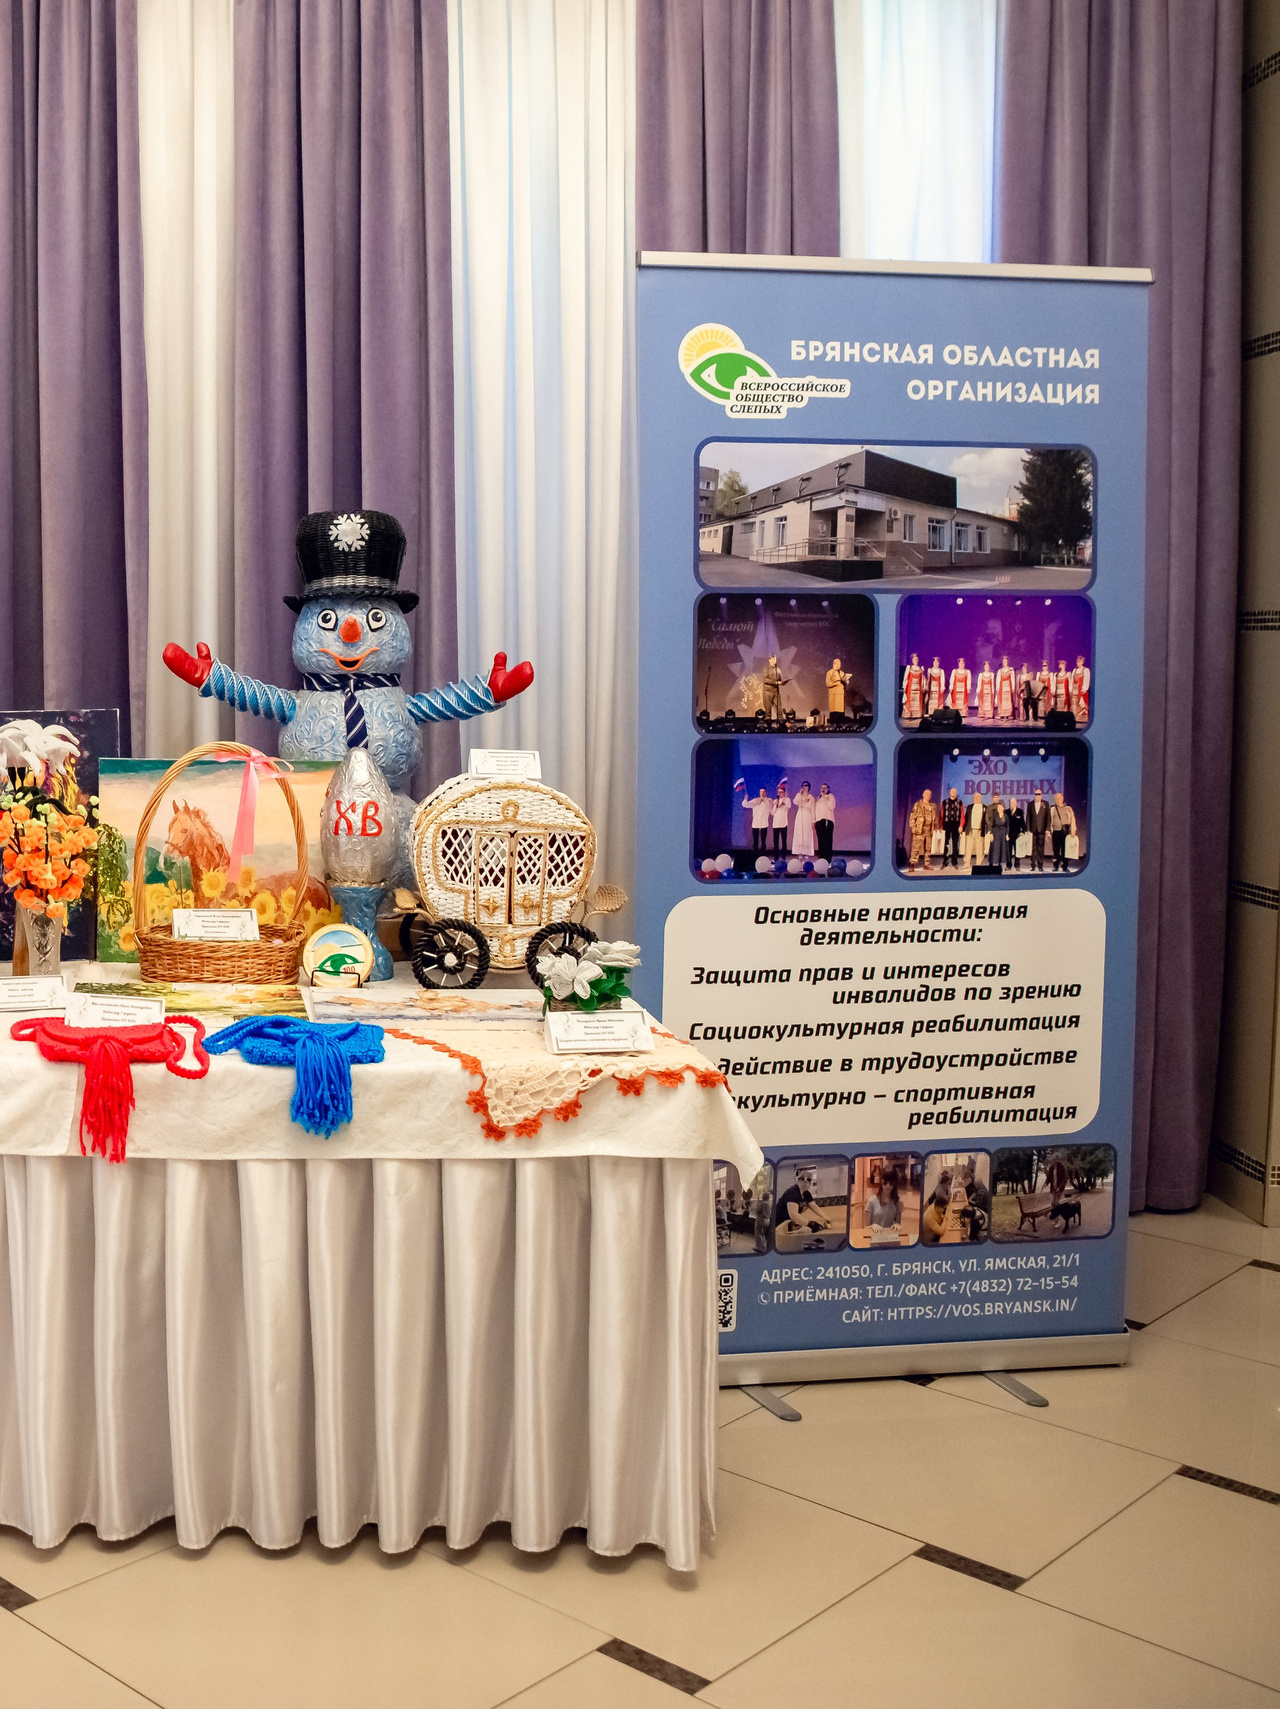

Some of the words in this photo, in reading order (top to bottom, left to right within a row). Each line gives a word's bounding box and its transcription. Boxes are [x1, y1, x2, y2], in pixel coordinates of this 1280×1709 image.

[790, 339, 934, 365] БРЯНСКАЯ
[942, 343, 1100, 369] ОБЛАСТНАЯ
[735, 393, 804, 404] ОБЩЕСТВО
[740, 381, 846, 393] ВСЕРОССИЙСКОЕ
[906, 379, 1100, 406] ОРГАНИЗАЦИЯ
[730, 404, 783, 414] СЛЕПЫХ
[967, 759, 1008, 776] ЭХО
[963, 779, 1057, 796] ВОЕННЫХ
[754, 906, 870, 925] Основные
[877, 905, 1029, 925] направления
[799, 926, 984, 947] деятельности:
[690, 966, 792, 987] Защита
[798, 967, 854, 986] прав
[861, 966, 876, 981] и
[882, 963, 1011, 982] интересов
[832, 983, 957, 1005] инвалидов
[963, 986, 992, 1001] по
[998, 983, 1082, 1004] зрению
[688, 1020, 905, 1043] Социокультурная
[910, 1013, 1081, 1038] реабилитация
[717, 1057, 833, 1076] действие
[839, 1058, 853, 1072] в
[860, 1047, 1078, 1075] трудоустройстве
[731, 1090, 867, 1113] культурно
[893, 1084, 1036, 1106] спортивная
[907, 1105, 1078, 1130] реабилитация
[760, 1267, 813, 1285] АДРЕС:
[816, 1264, 874, 1280] 241050,
[877, 1263, 889, 1277] Г.
[892, 1260, 955, 1276] БРЯНСК,
[958, 1258, 981, 1272] УЛ.
[984, 1255, 1050, 1271] ЯМСКАЯ,
[1052, 1252, 1080, 1268] 21/1
[773, 1285, 863, 1304] ПРИЁМНАЯ:
[866, 1281, 947, 1299] ТЕЛ./ФАКС
[950, 1277, 1013, 1298] +7(4832)
[1016, 1274, 1079, 1291] 72-15-54
[842, 1305, 884, 1324] САЙТ:
[887, 1296, 1078, 1321] HTTPS://VOS.BRYANSK.IN/
